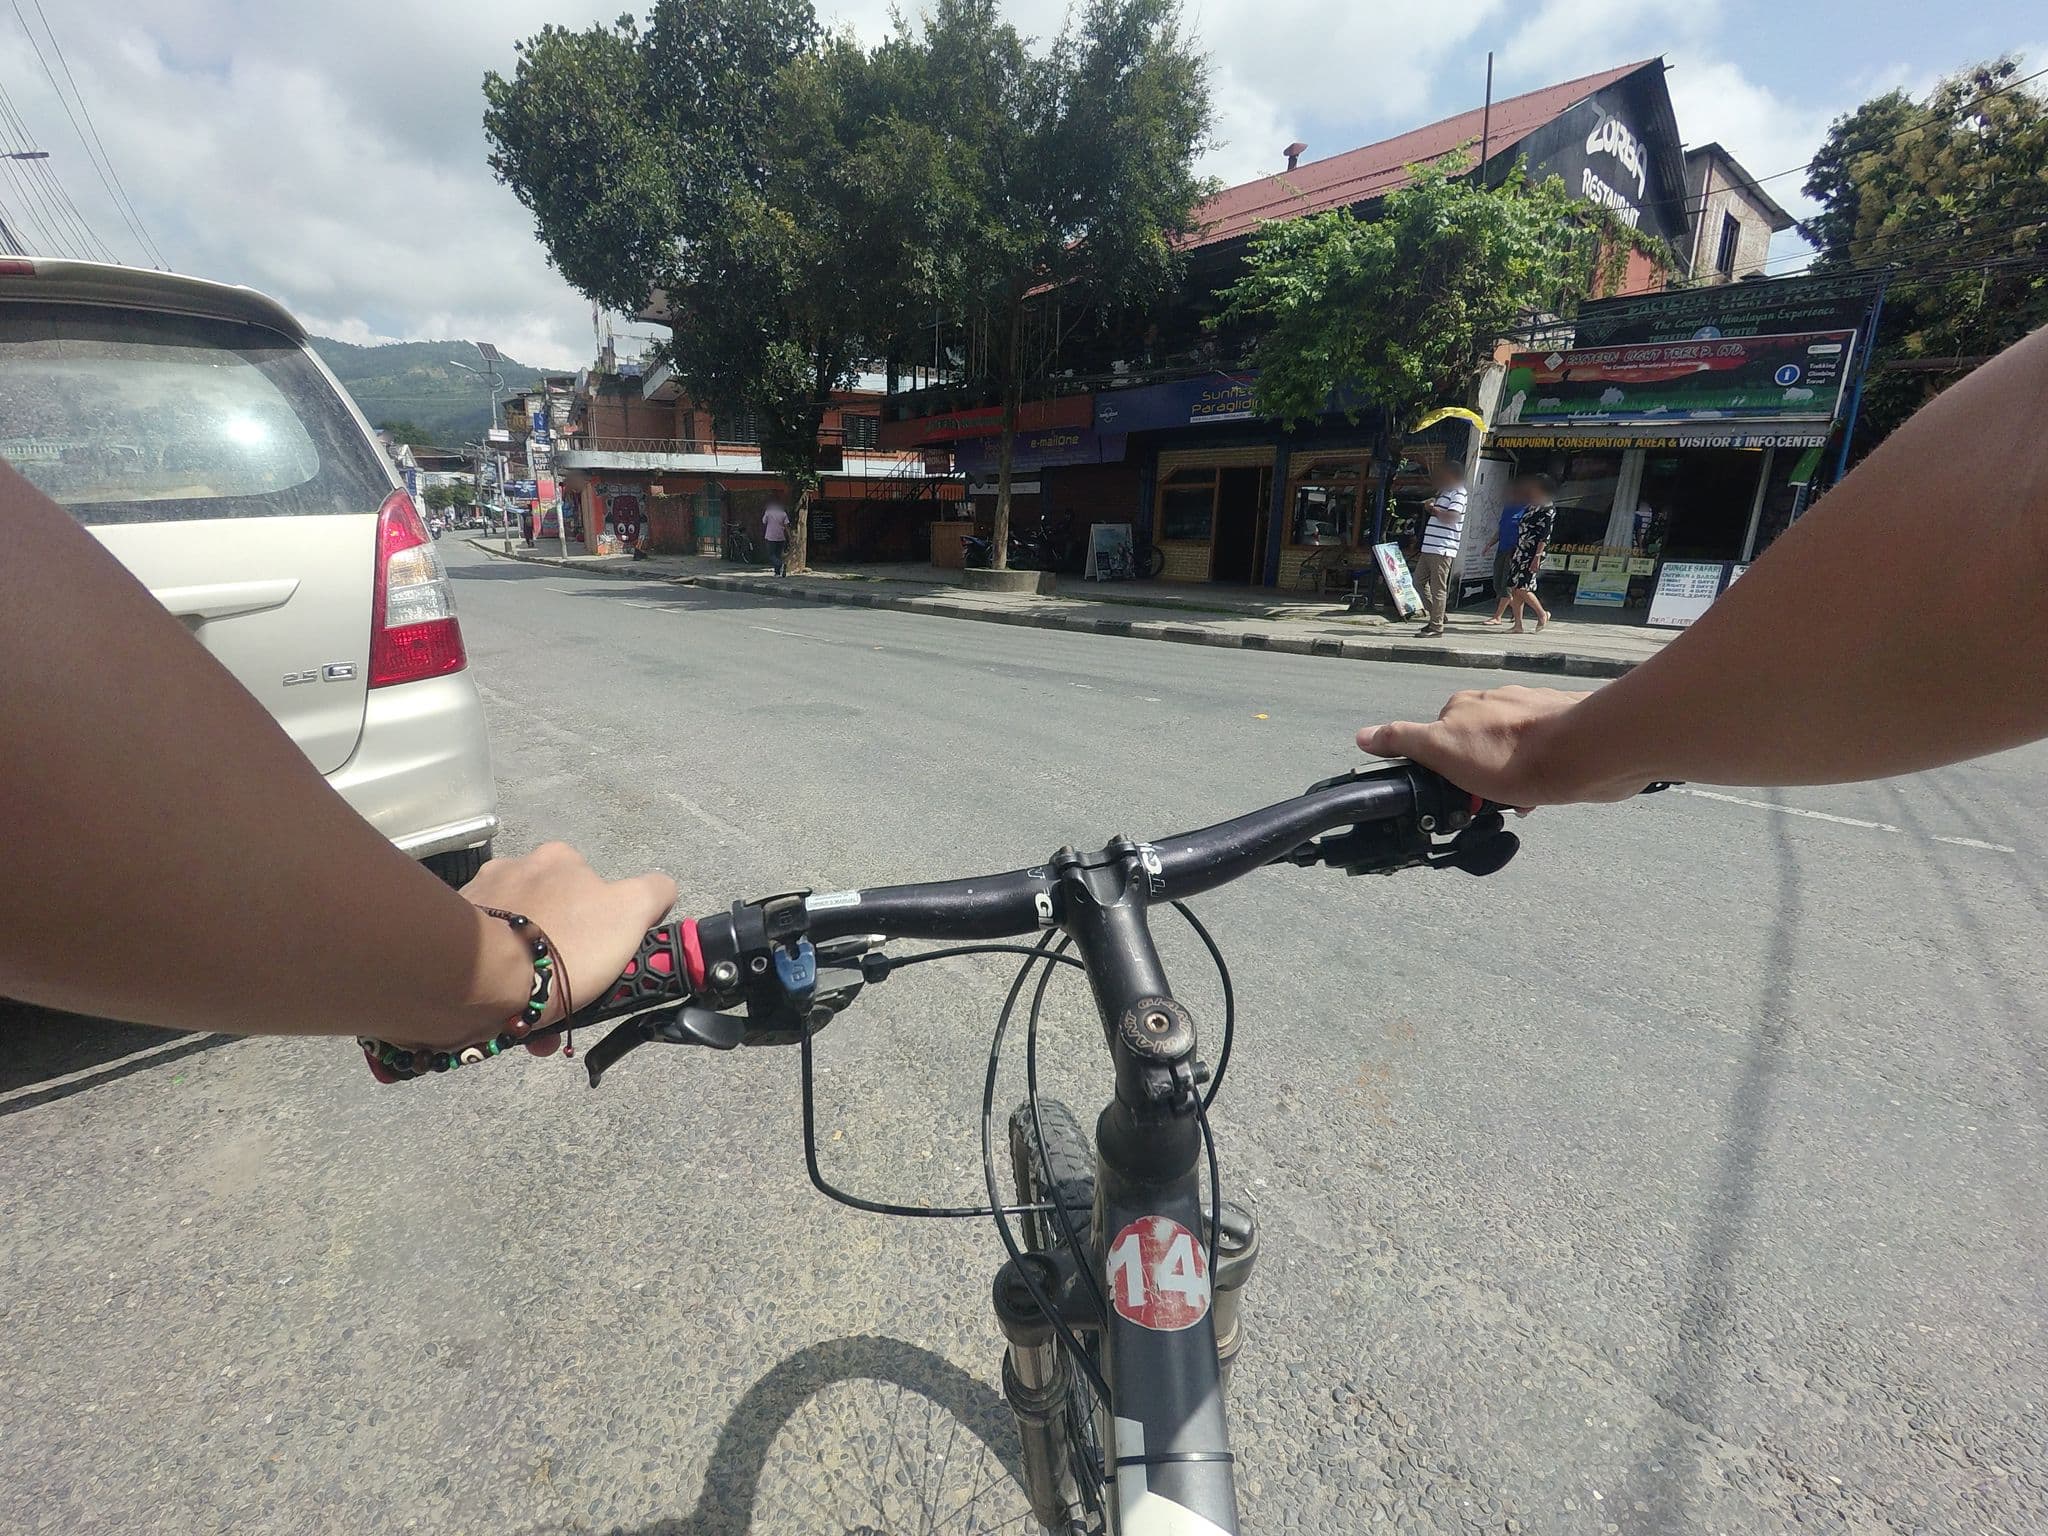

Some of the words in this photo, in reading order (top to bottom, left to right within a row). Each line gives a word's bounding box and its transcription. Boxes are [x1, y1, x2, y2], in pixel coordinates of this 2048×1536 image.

[1496, 438, 1554, 448] ANNAPURNA
[1557, 438, 1631, 448] CONSERVATION
[1635, 438, 1665, 448] AREA
[1668, 438, 1677, 447] &
[1679, 436, 1730, 447] VISITOR
[1776, 436, 1826, 447] CENTER
[1663, 564, 1692, 572] JUNGLE
[1110, 1233, 1208, 1308] 14
